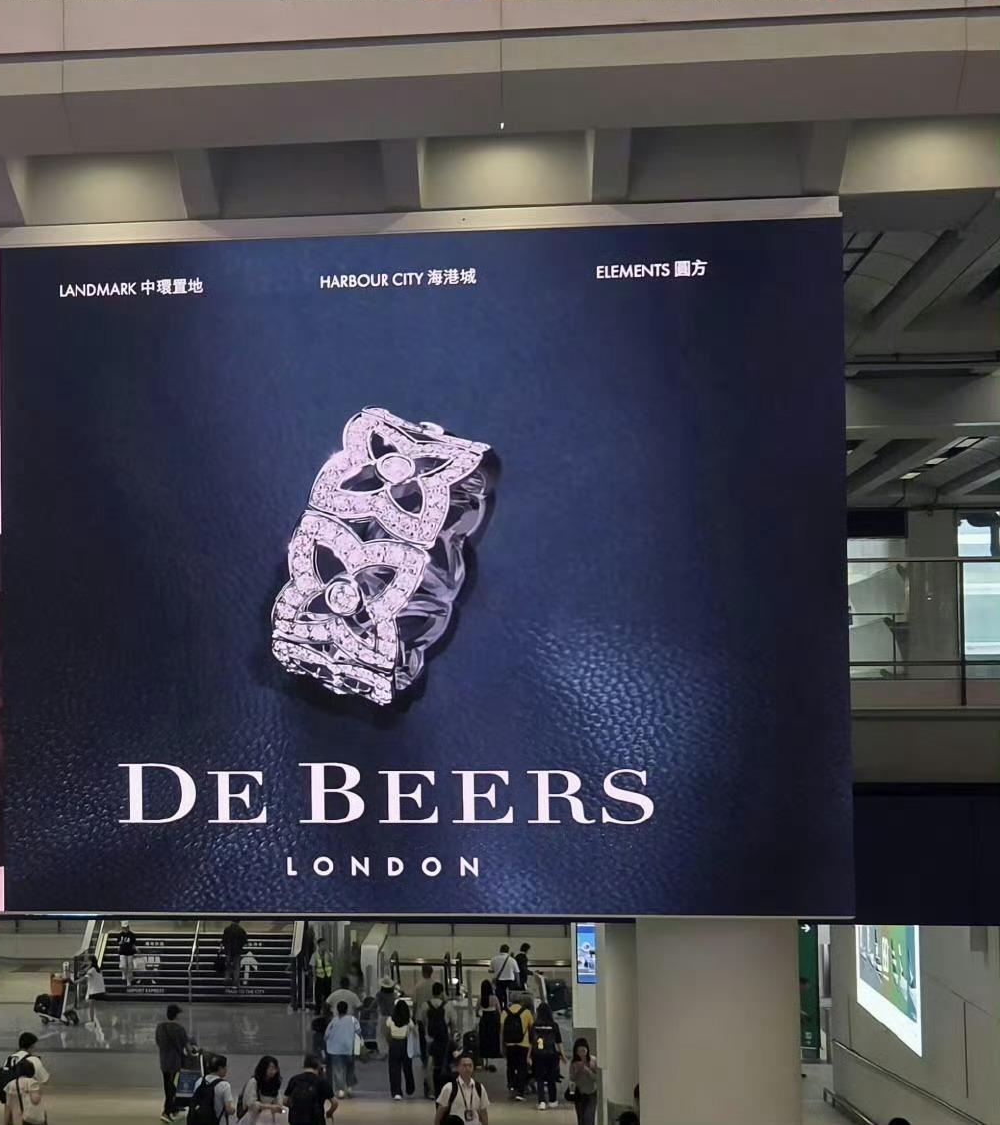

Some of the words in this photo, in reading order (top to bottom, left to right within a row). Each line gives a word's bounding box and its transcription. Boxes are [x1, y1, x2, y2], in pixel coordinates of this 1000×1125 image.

[319, 273, 389, 289] HARBOUR
[392, 272, 424, 287] CITY
[427, 267, 477, 286] 海港城
[596, 263, 671, 279] ELEMENTS
[59, 282, 137, 298] LANDMARK
[140, 276, 204, 296] 中環置地
[117, 762, 268, 824] DE
[298, 761, 655, 825] BEERS
[286, 855, 480, 877] LONDON
